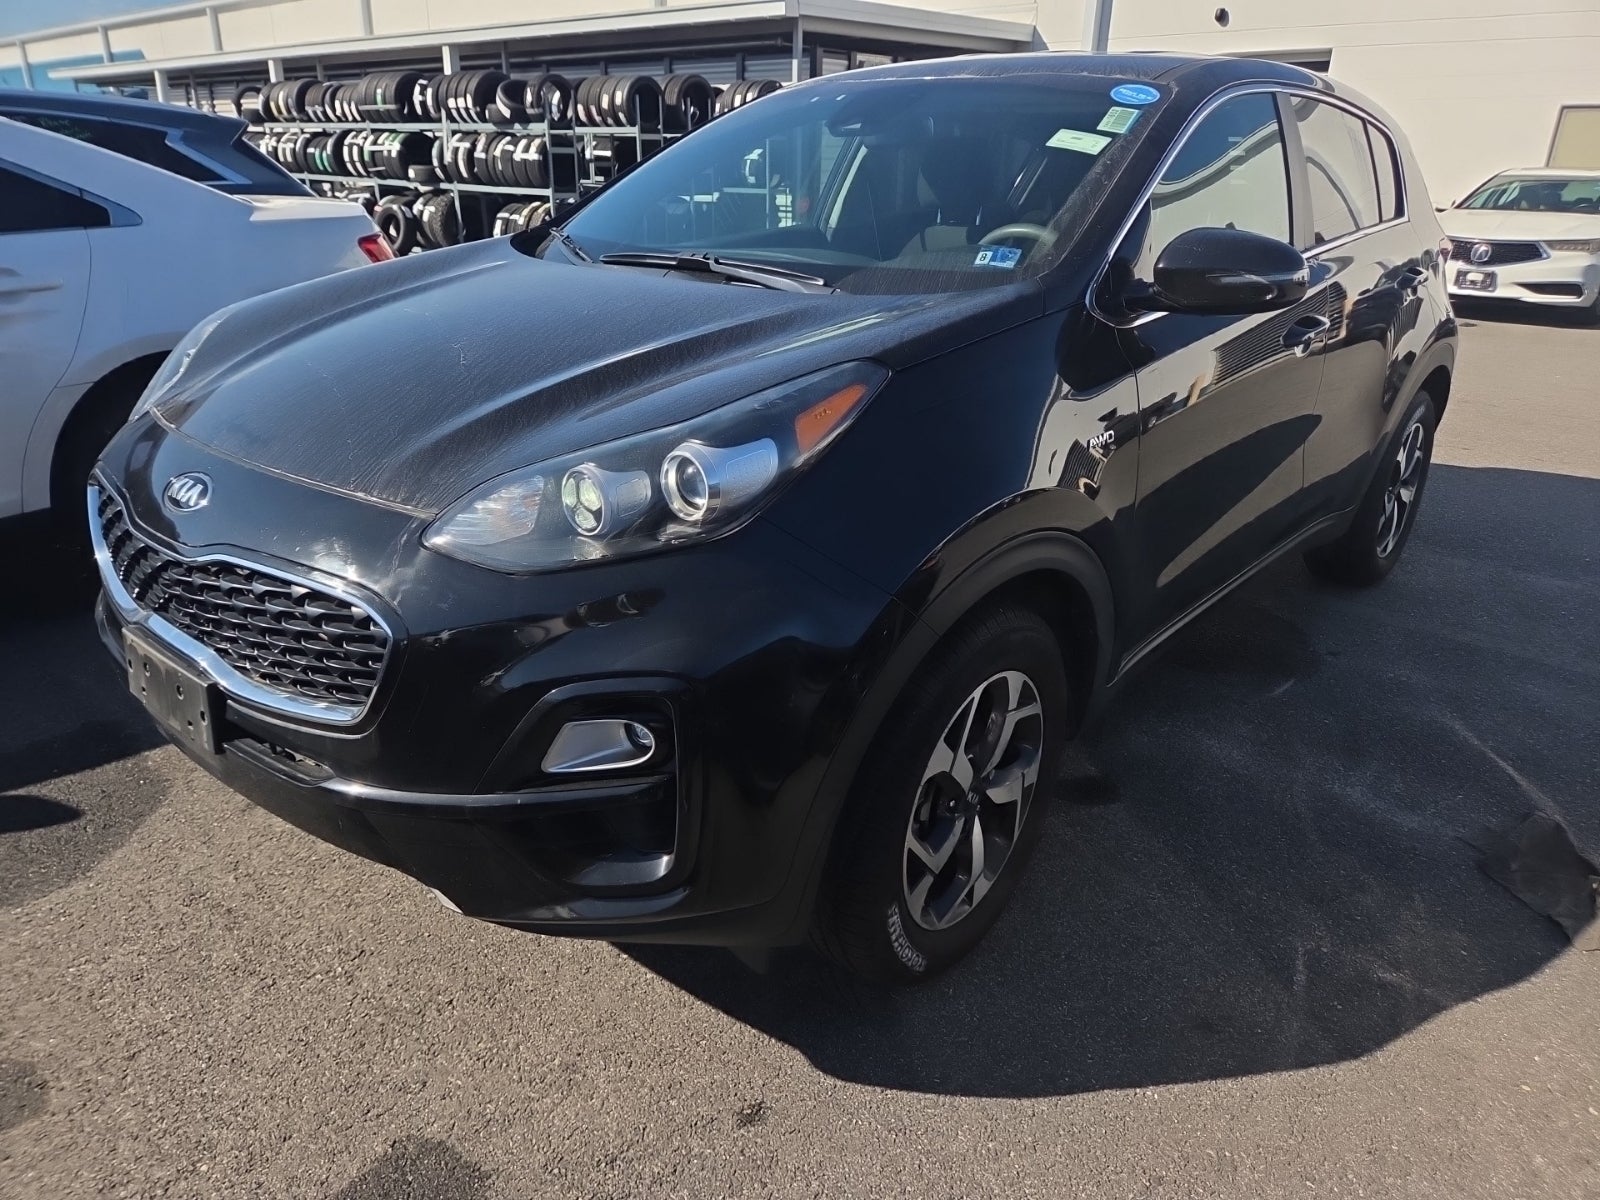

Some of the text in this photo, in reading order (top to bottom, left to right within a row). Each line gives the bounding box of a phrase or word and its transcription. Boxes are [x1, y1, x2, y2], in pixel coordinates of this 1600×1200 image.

[979, 252, 988, 262] 8
[1089, 430, 1115, 450] AWD
[167, 477, 205, 507] KIA
